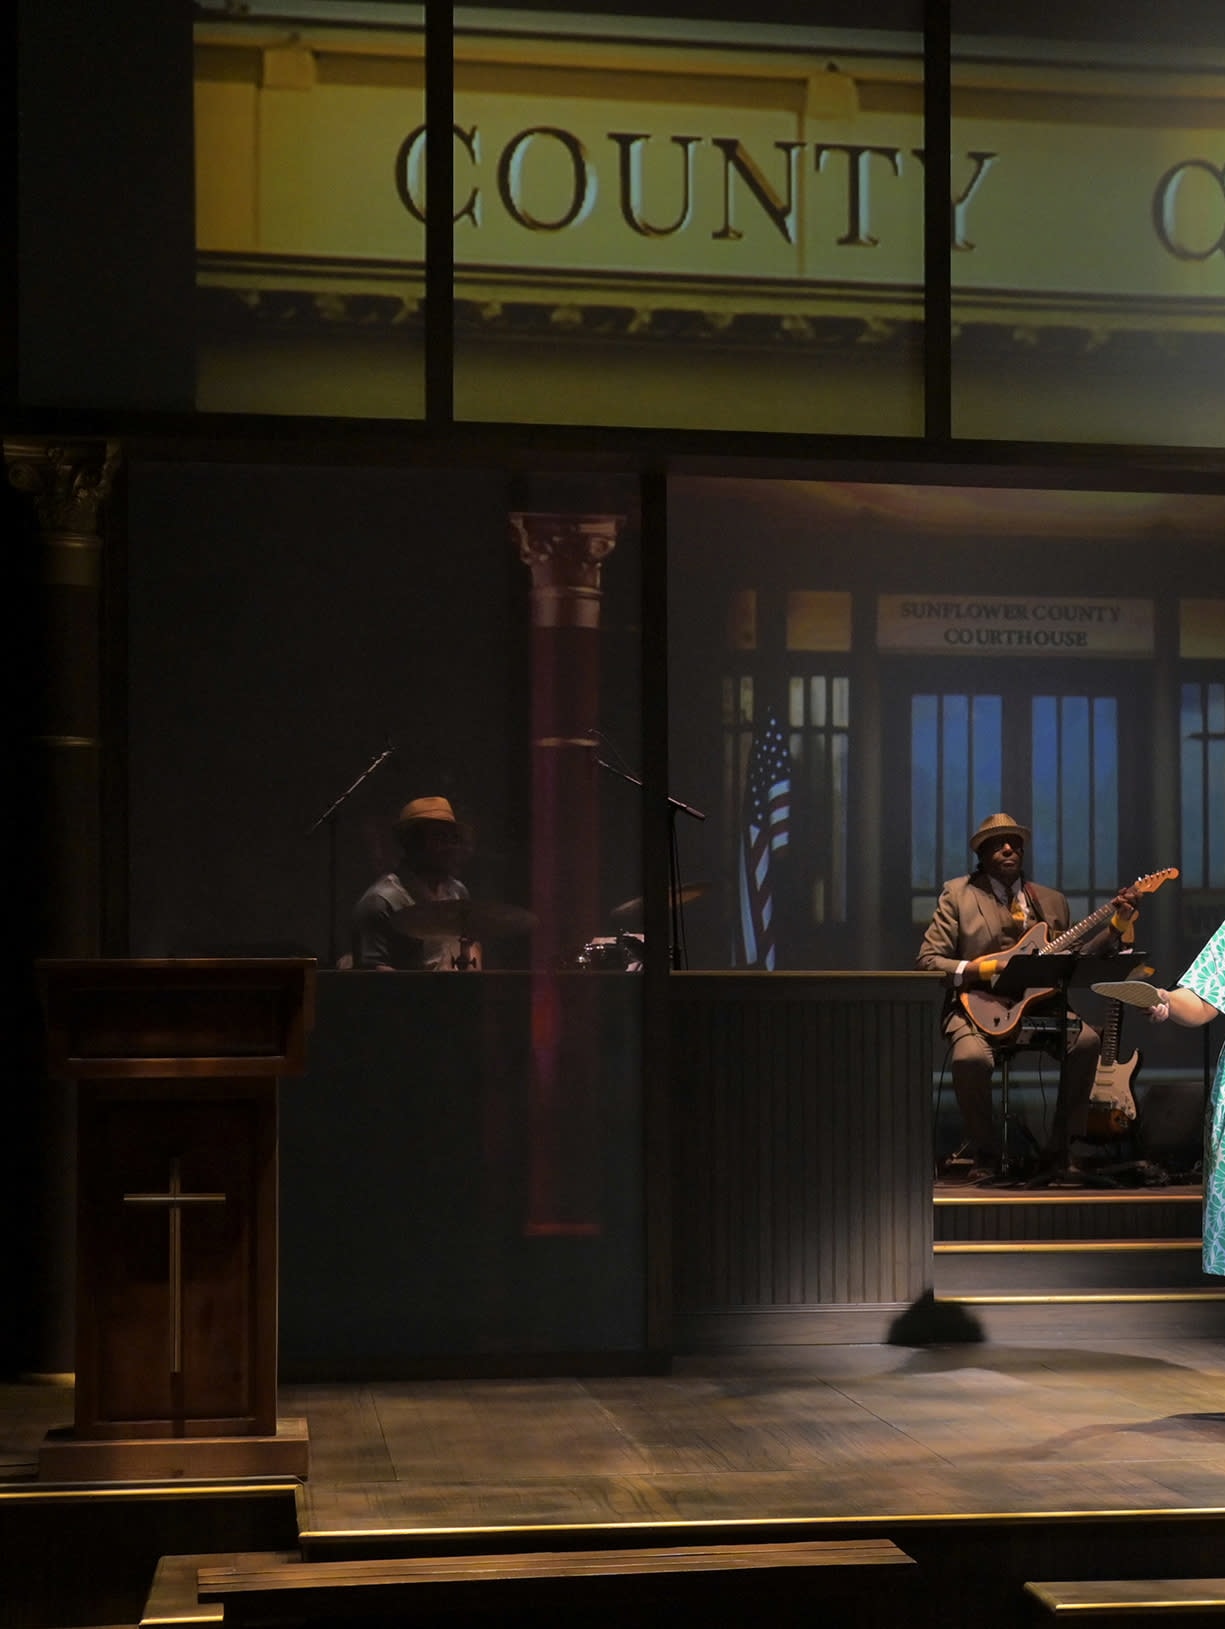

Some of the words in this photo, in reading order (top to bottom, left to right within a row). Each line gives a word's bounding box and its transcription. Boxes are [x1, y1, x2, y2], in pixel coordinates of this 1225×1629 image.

[395, 122, 997, 251] COUNTY
[901, 601, 1029, 621] SUNFLOWER
[1031, 604, 1121, 622] COUNTY
[944, 627, 1088, 647] COURTHOUSE
